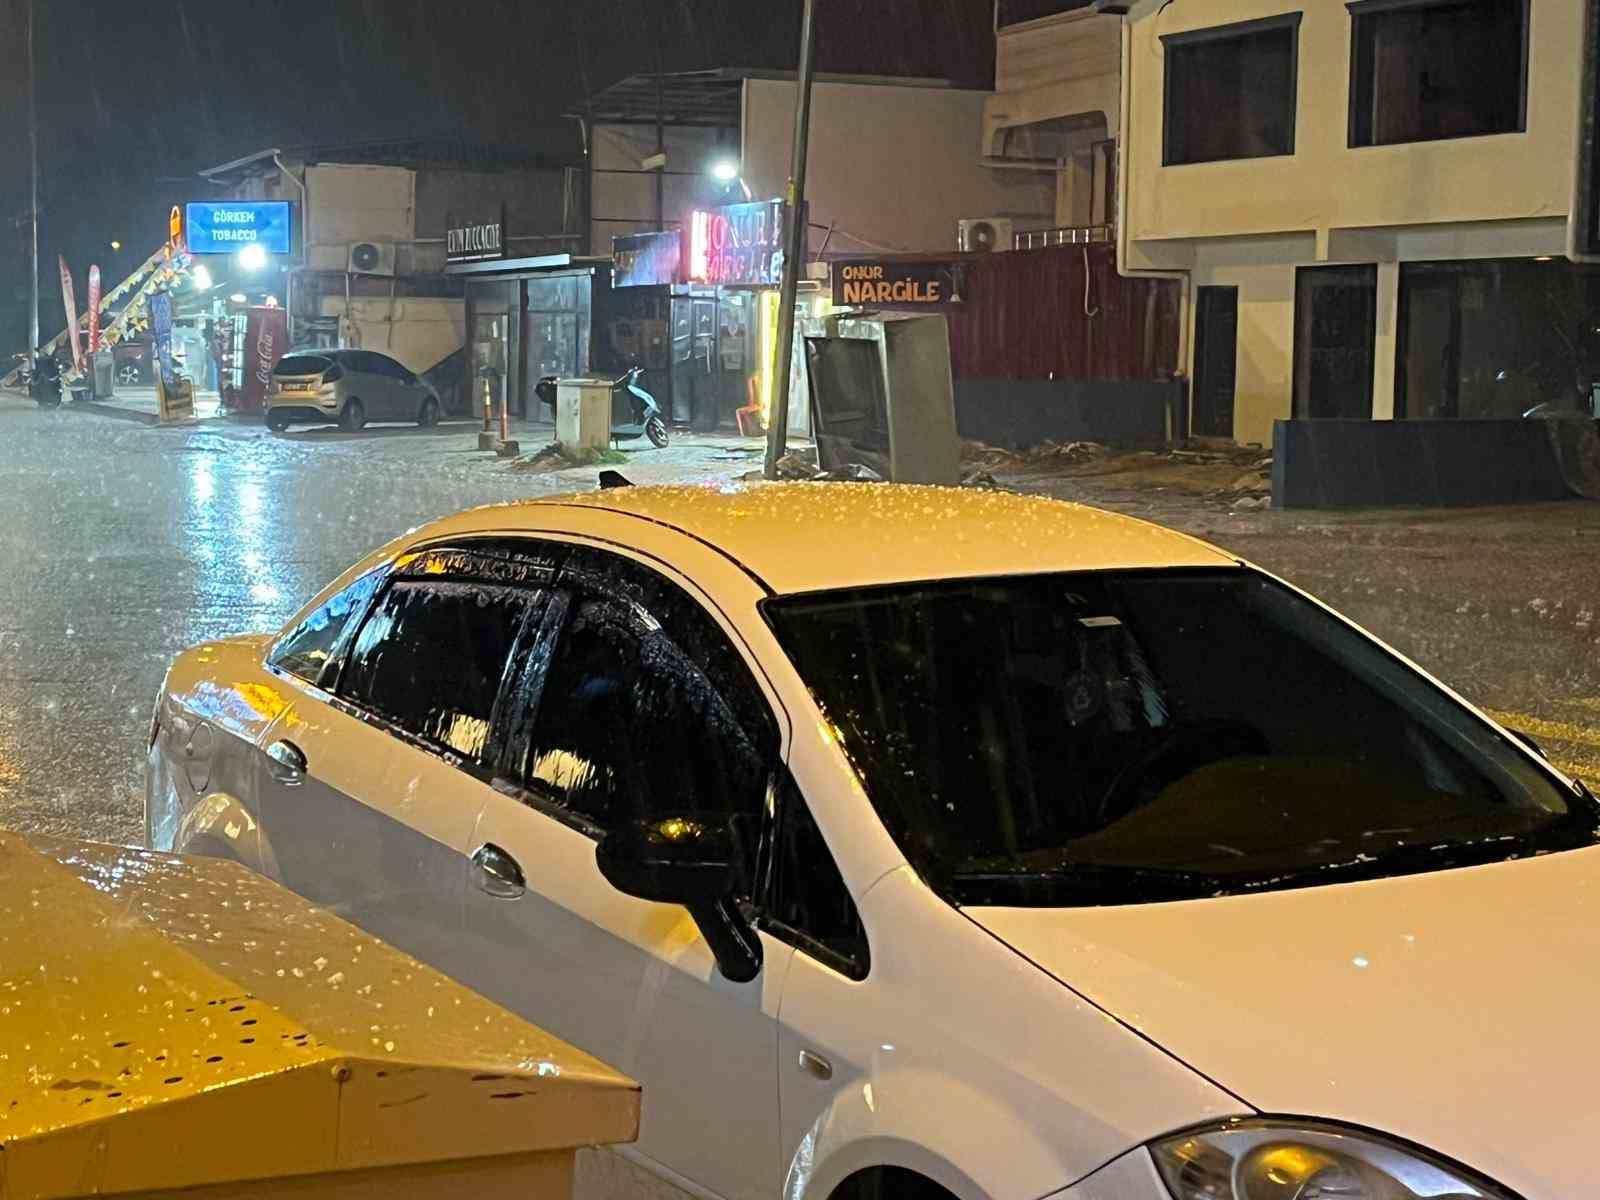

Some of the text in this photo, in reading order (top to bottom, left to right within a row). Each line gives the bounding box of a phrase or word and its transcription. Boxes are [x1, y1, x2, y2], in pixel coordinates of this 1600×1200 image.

[213, 209, 255, 224] GÖRKEM
[211, 229, 257, 241] TOBACCO
[842, 266, 883, 280] ONUR
[843, 277, 940, 304] NARGİLE
